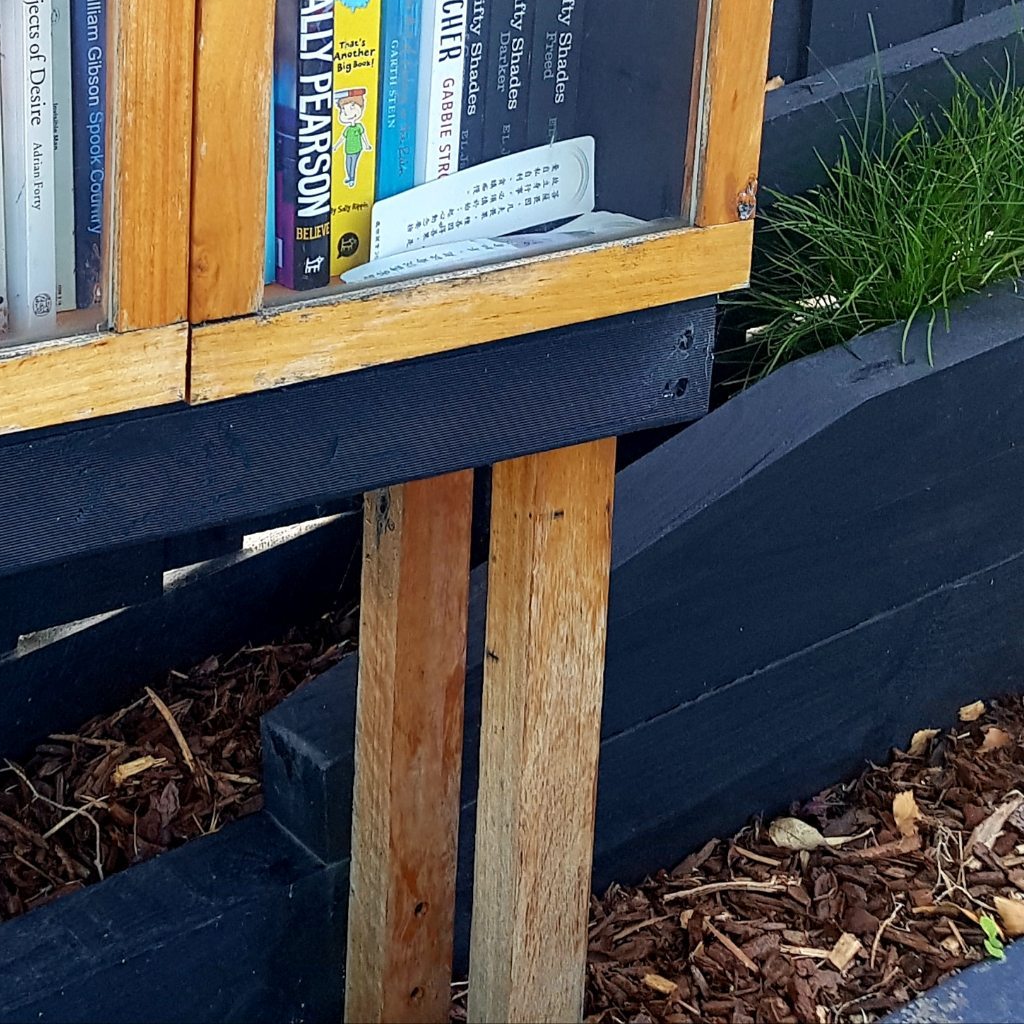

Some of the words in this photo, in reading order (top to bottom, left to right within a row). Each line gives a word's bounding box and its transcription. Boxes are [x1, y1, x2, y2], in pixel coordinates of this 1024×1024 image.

[29, 43, 47, 62] of
[87, 46, 101, 106] Gibson
[333, 48, 376, 60] Another
[337, 61, 352, 73] Big
[389, 40, 400, 85] GARTH
[467, 43, 482, 116] Shades
[496, 31, 510, 93] Darker
[507, 38, 524, 110] Shades
[543, 32, 557, 81] Freed
[554, 33, 573, 105] Shades
[30, 70, 46, 126] Desire
[388, 89, 397, 129] STEIN
[440, 78, 455, 138] GABBIE
[32, 142, 43, 178] Adrian
[86, 111, 105, 165] Spook
[298, 72, 333, 217] PEARSON
[32, 182, 43, 210] Forty
[87, 169, 104, 234] Country
